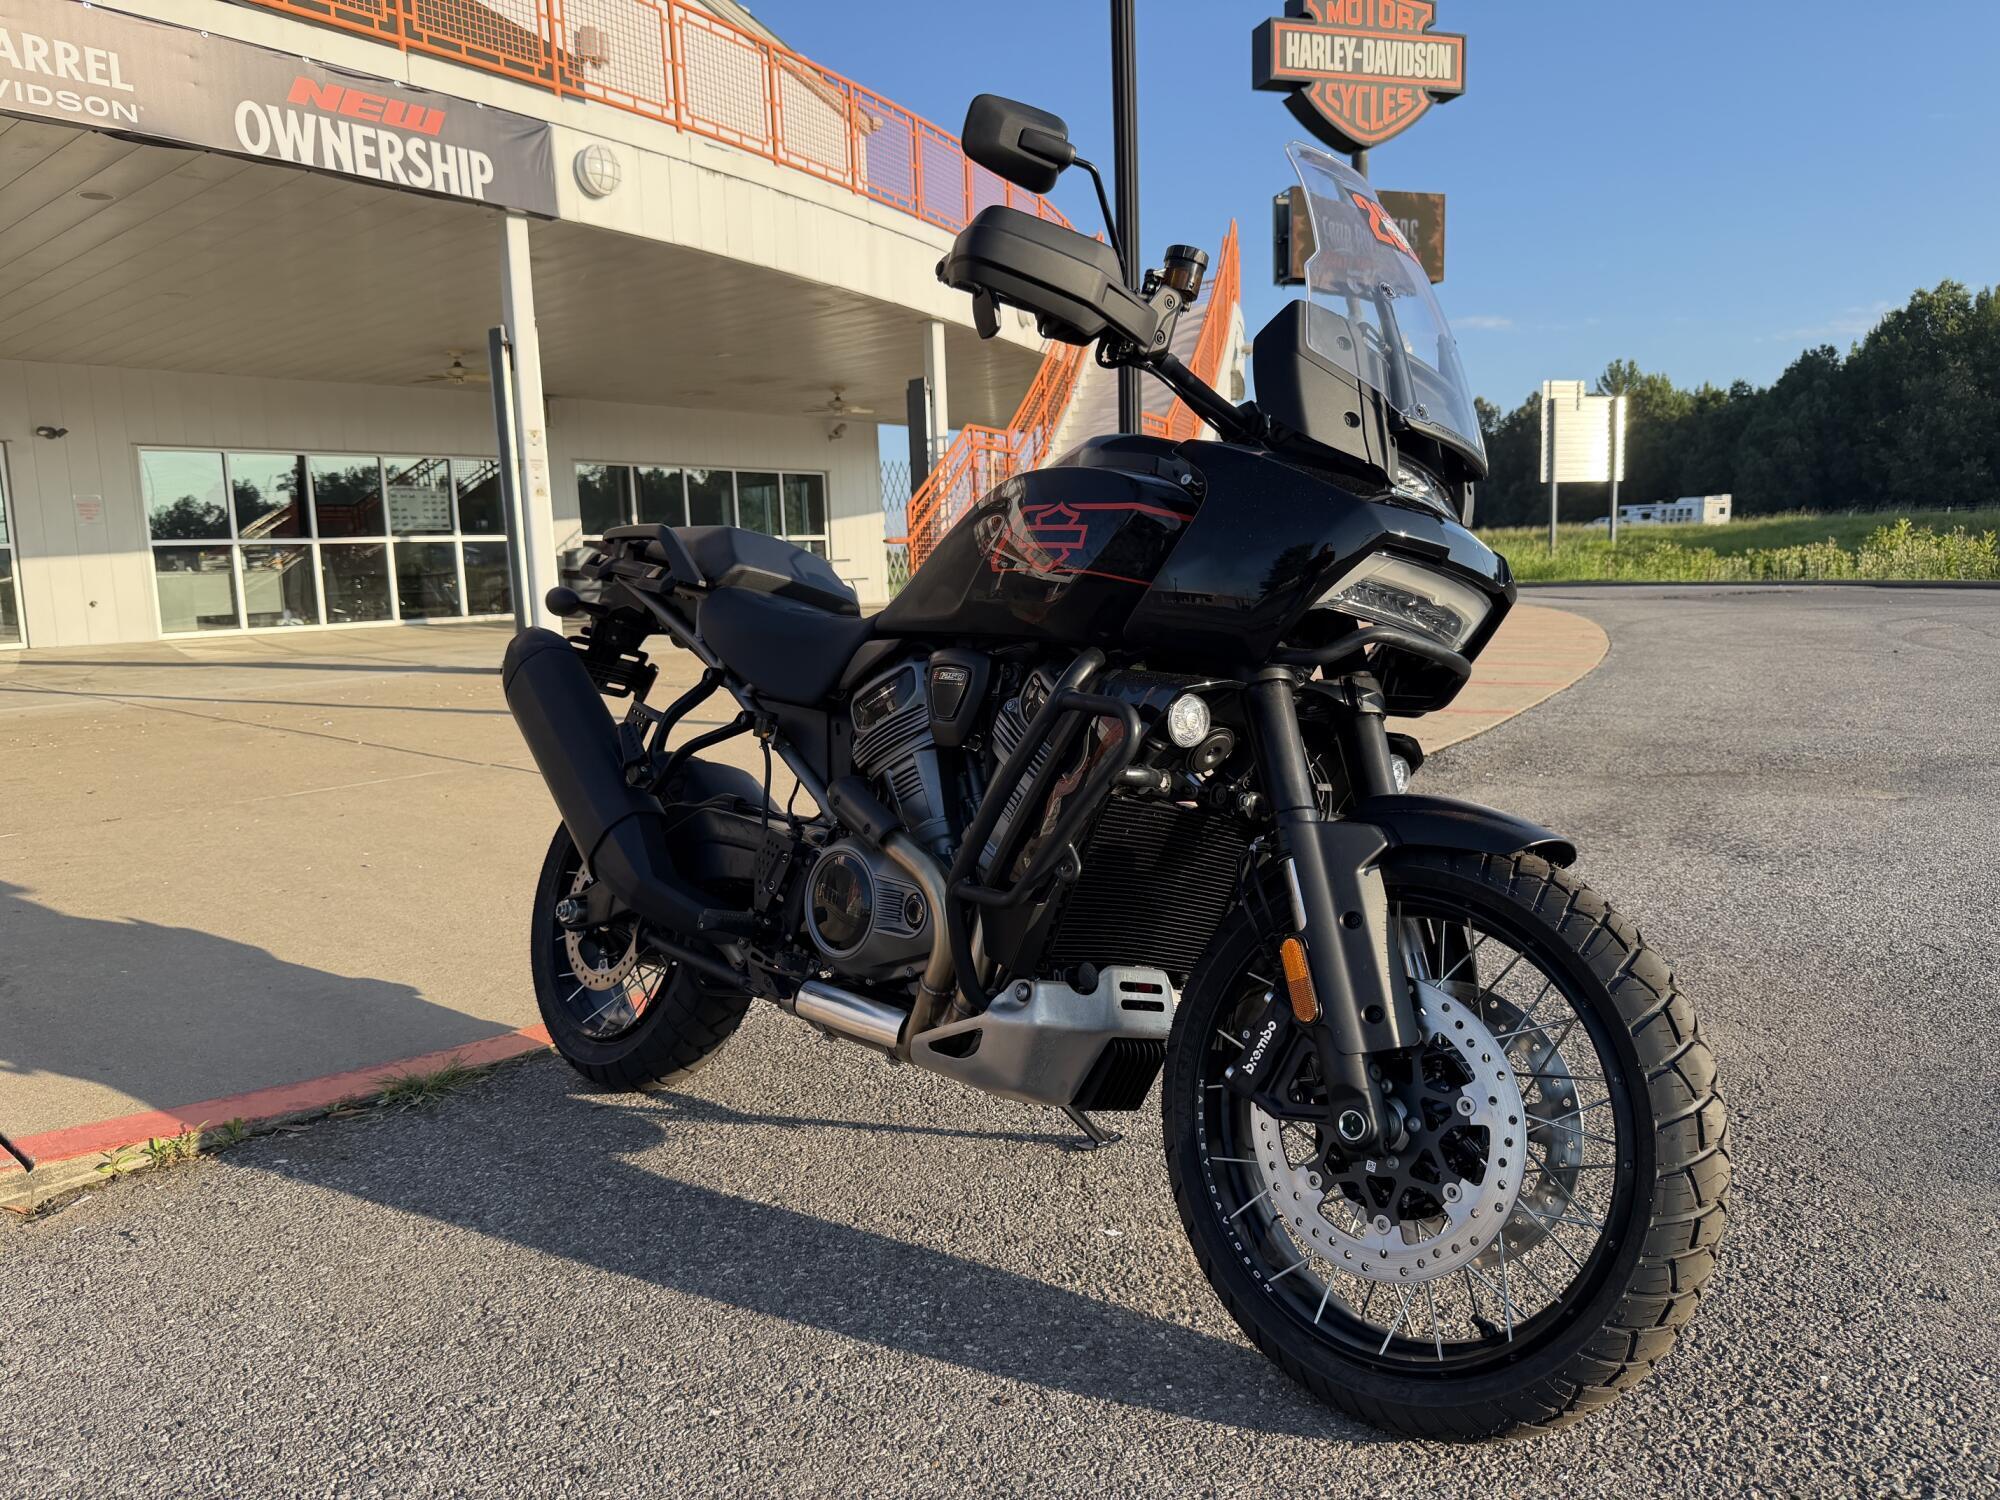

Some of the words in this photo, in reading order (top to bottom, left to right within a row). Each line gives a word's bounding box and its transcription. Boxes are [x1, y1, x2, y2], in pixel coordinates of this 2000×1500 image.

[1327, 0, 1414, 30] MOTOR
[0, 27, 134, 92] ARREL
[1285, 31, 1451, 79] HARLEY-DAVIDSON
[287, 75, 446, 136] NEW
[1325, 82, 1412, 131] CYCLES
[234, 99, 494, 200] OWNERSHIP
[1242, 1020, 1277, 1075] brembo
[1198, 1079, 1273, 1293] HARLEY-DAVIDSON
